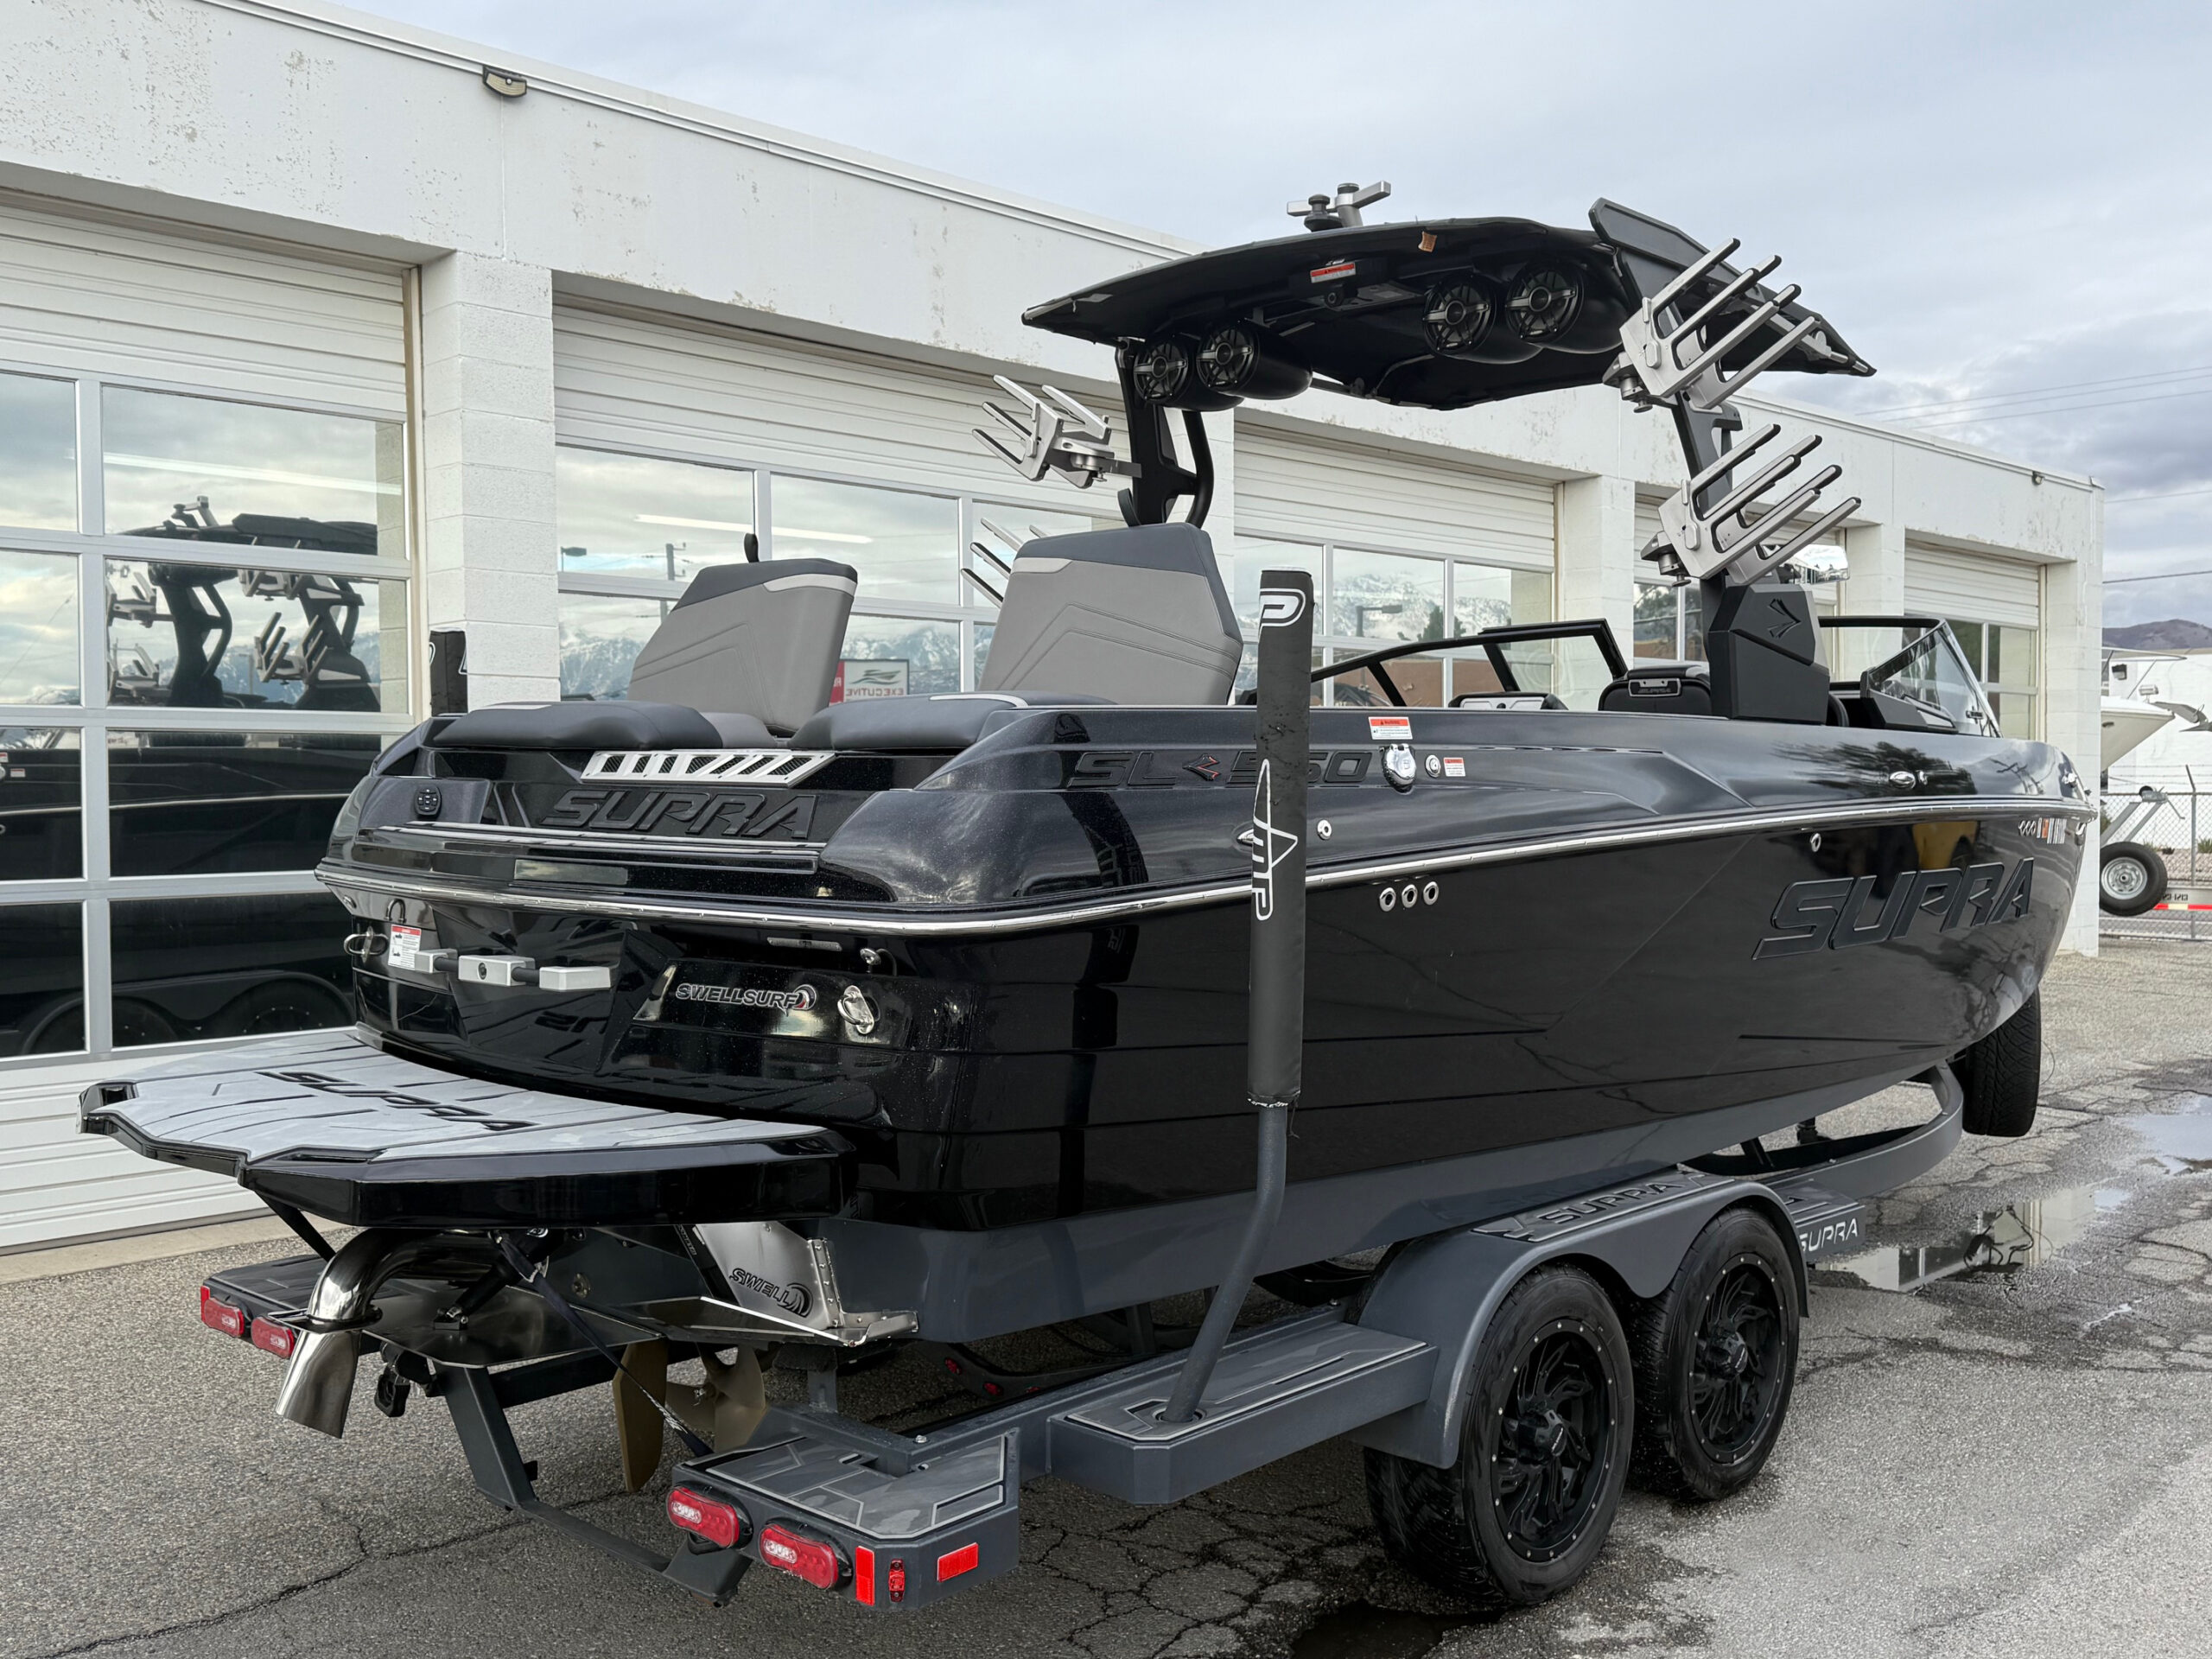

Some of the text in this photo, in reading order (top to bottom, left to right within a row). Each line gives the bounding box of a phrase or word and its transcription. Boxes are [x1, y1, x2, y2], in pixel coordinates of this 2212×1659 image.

[1067, 751, 1178, 787] SL
[540, 789, 817, 840] SUPRA
[1751, 857, 2035, 961] SUPRA
[676, 982, 804, 1016] SWELLSURF
[254, 1071, 540, 1132] SUPRA
[1537, 1181, 1686, 1224] SUPRA
[1798, 1217, 1859, 1253] SUPRA
[728, 1267, 793, 1307] SWELL
